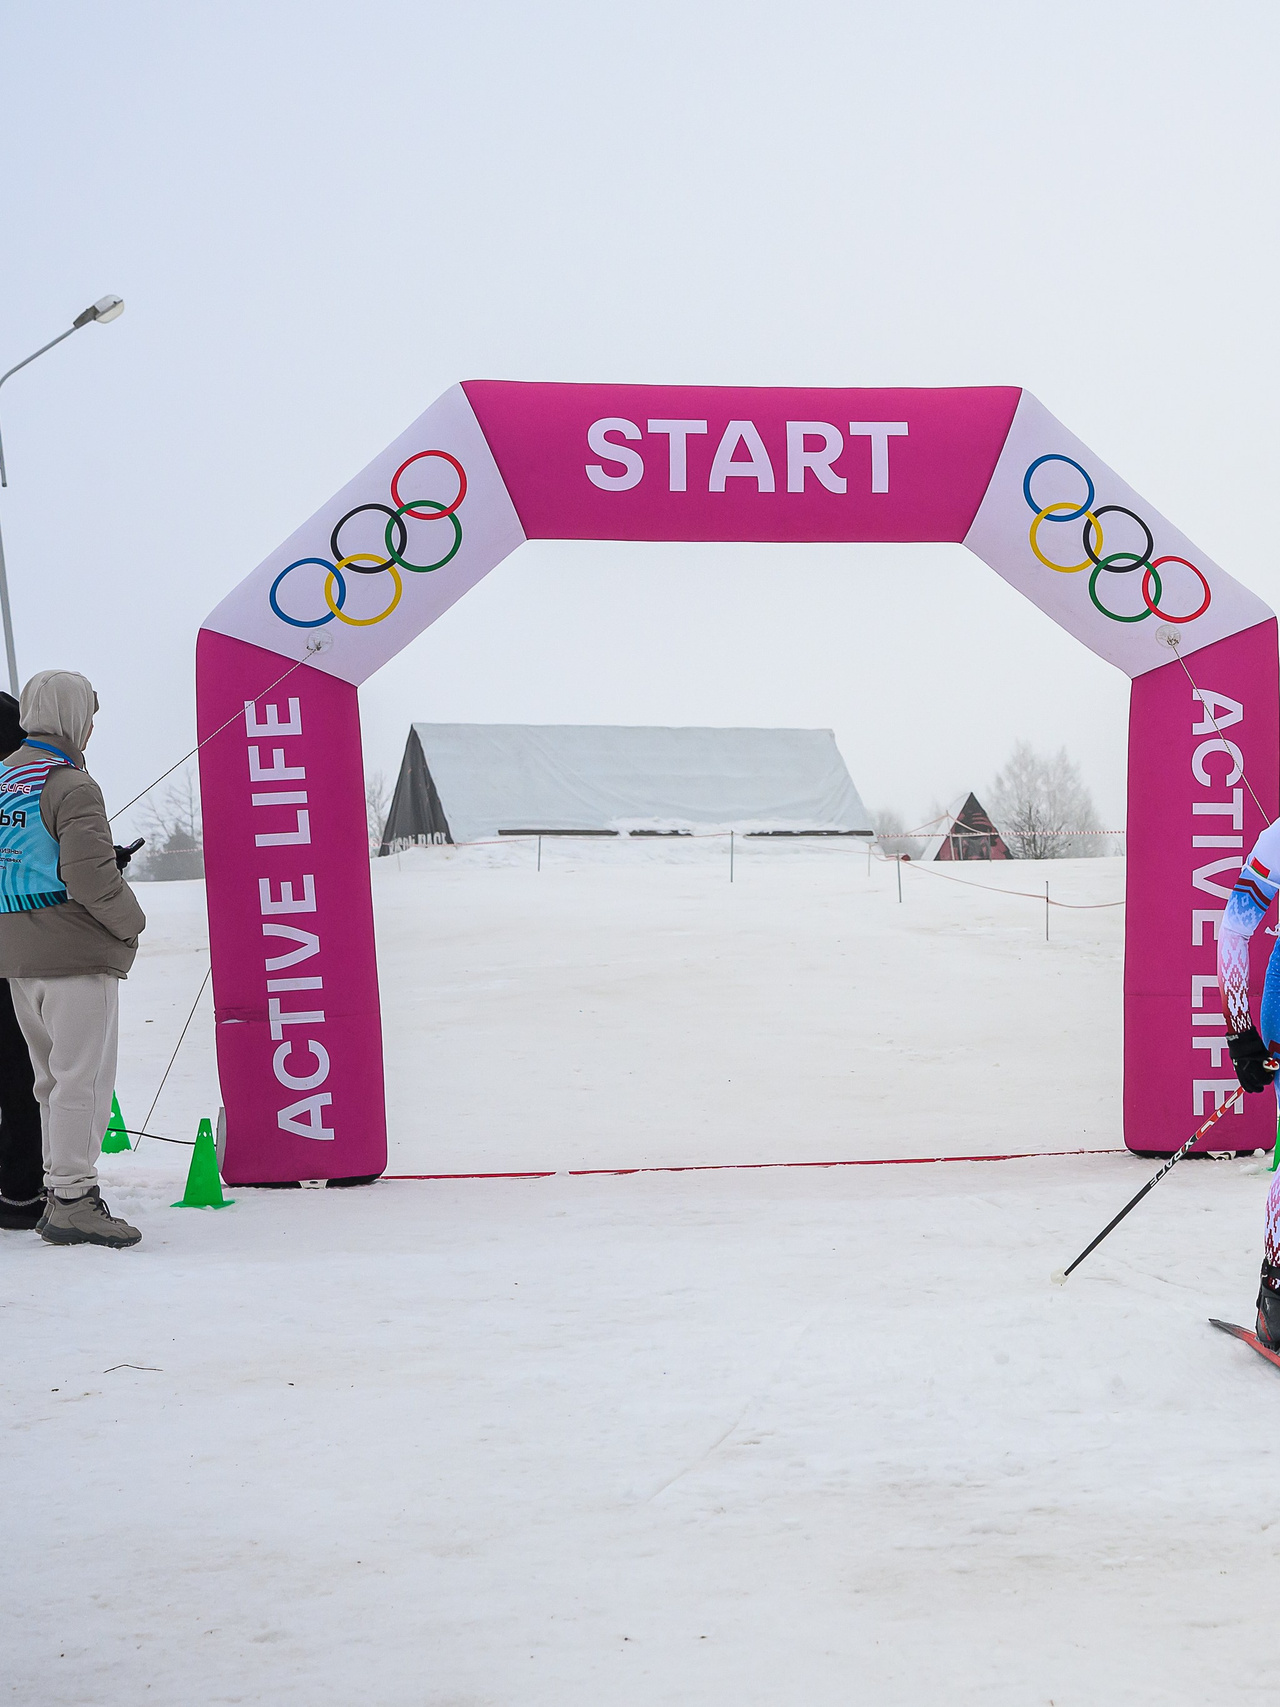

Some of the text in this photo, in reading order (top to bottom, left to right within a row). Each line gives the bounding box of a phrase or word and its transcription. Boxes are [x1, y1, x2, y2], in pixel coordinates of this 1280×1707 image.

[585, 417, 909, 494] START
[1191, 688, 1244, 946] ACTIVE
[244, 697, 335, 1140] ACTIVE LIFE
[1191, 975, 1244, 1116] LIFE
